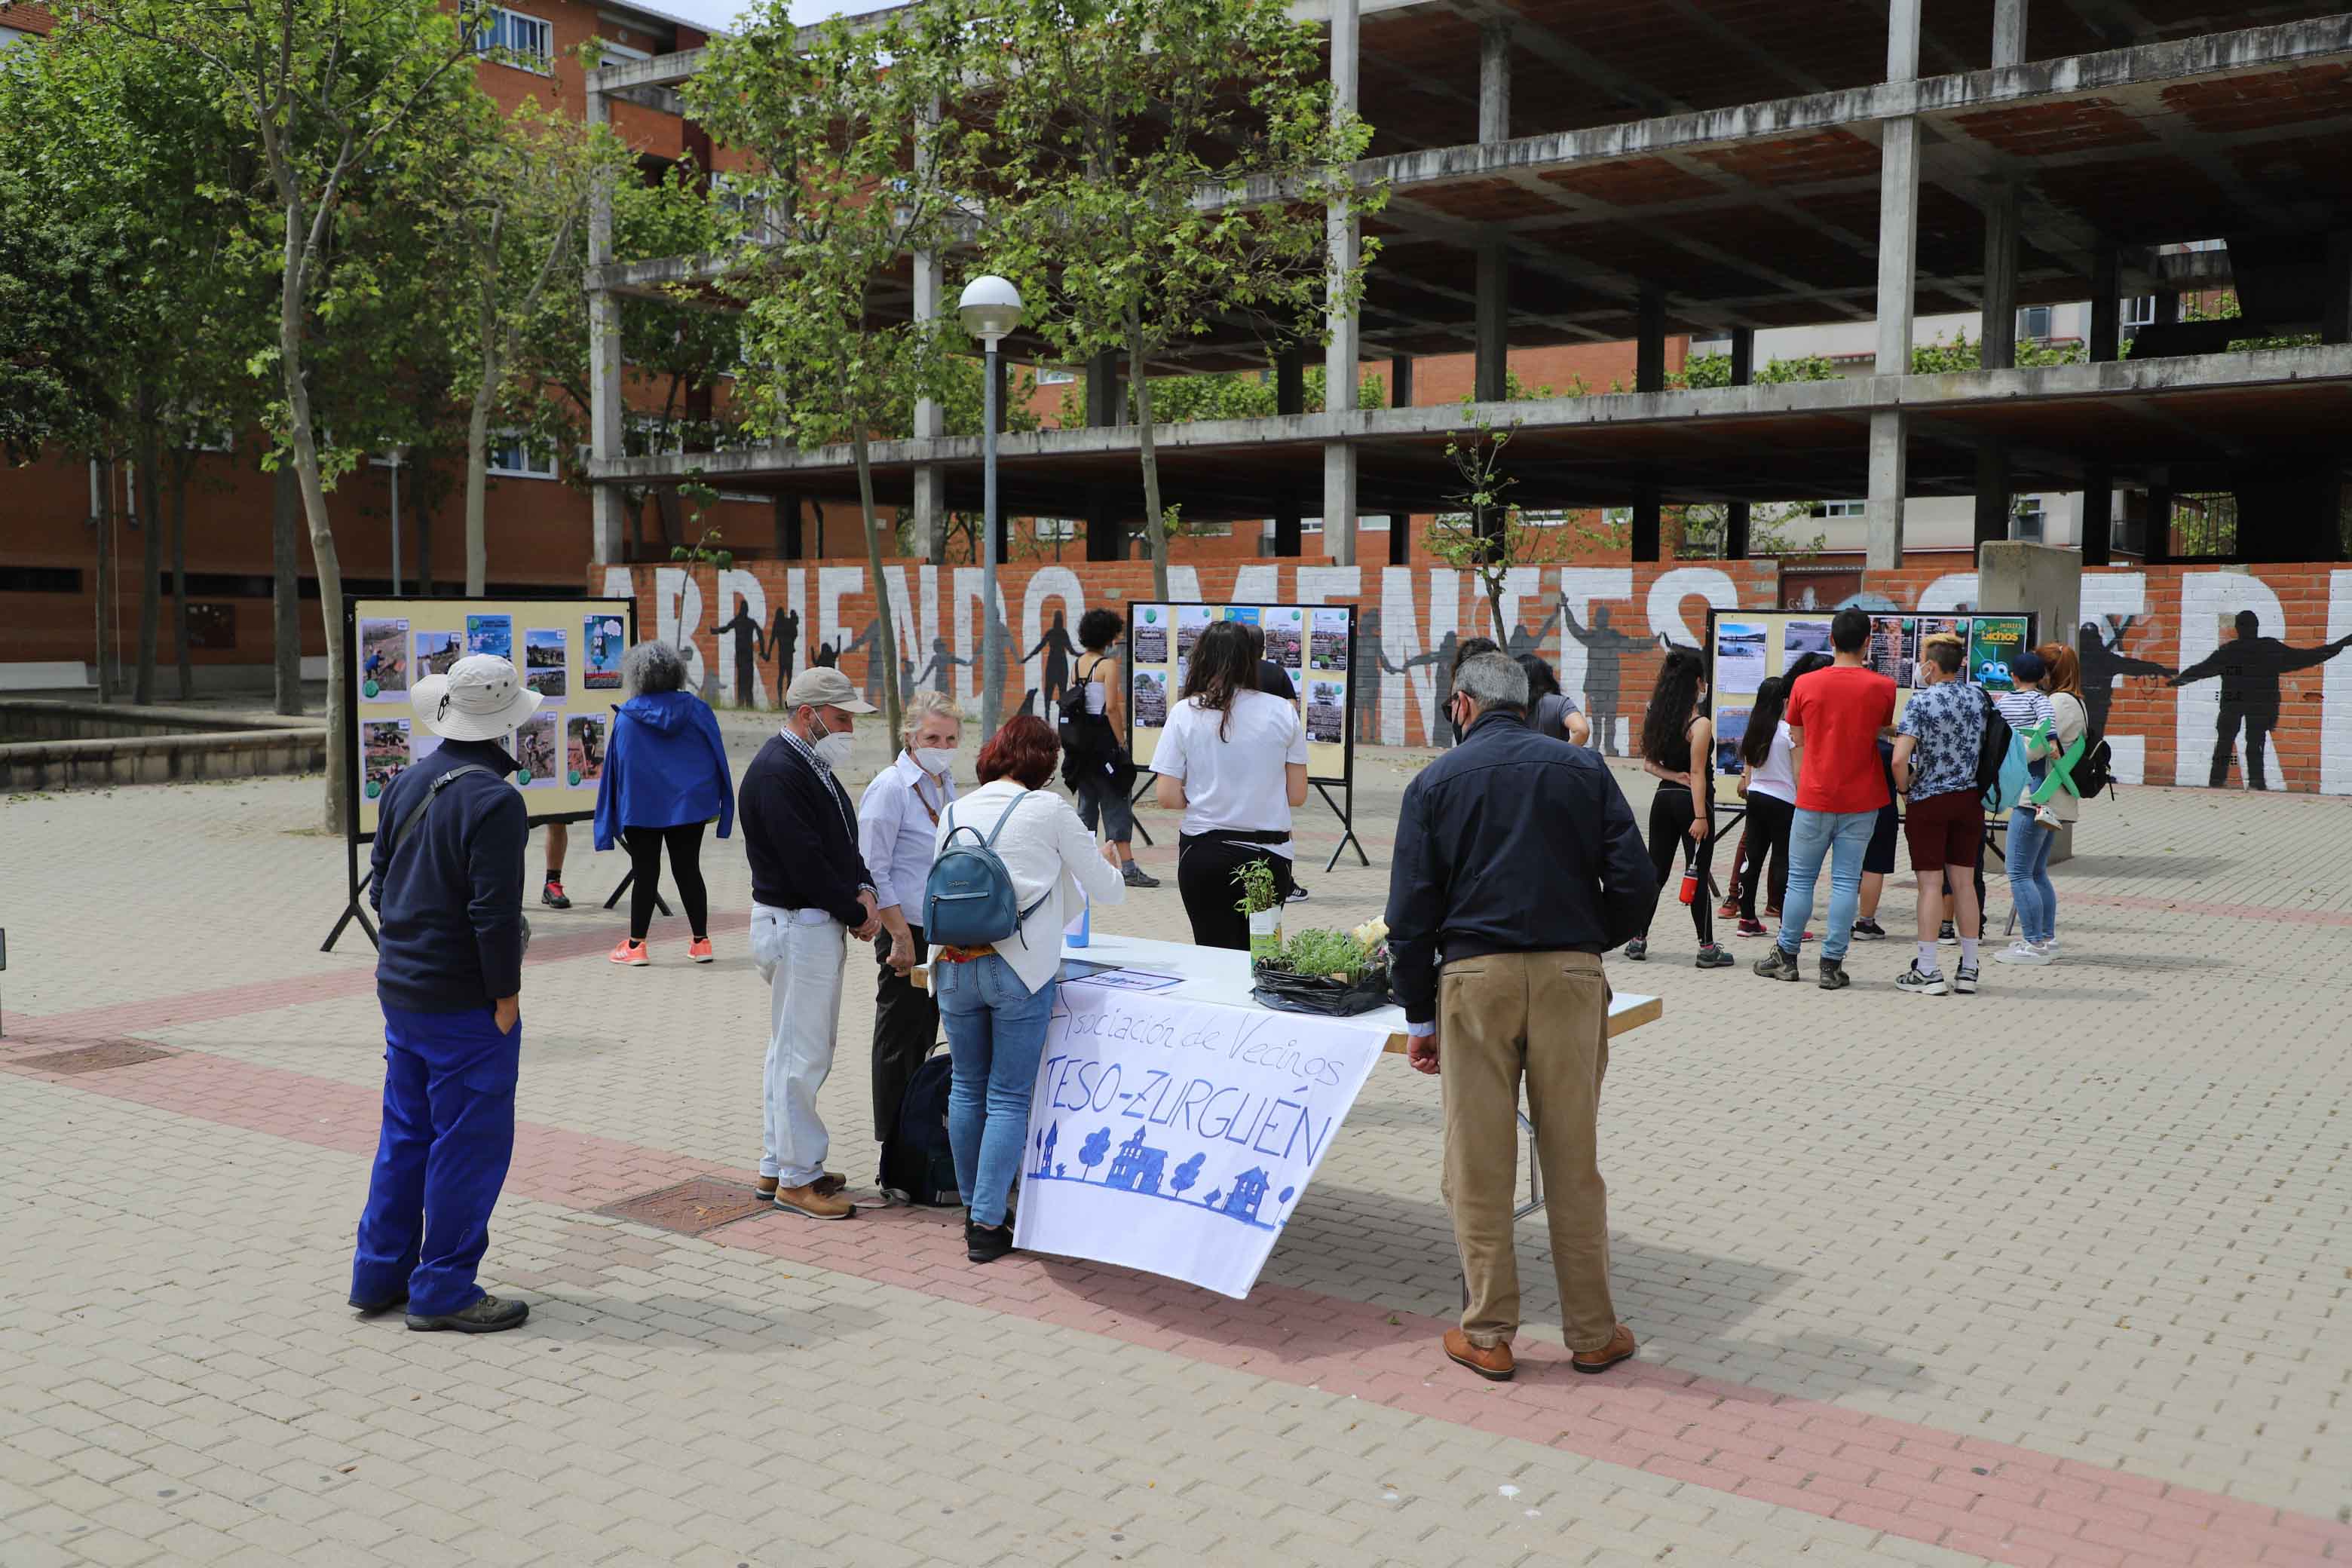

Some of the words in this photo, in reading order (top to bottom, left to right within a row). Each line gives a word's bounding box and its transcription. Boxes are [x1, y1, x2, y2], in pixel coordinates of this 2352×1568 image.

[1050, 985, 1174, 1049] Asociación
[1181, 1014, 1220, 1050] de
[1229, 1012, 1345, 1086] Vecinos
[1045, 1055, 1332, 1167] TESO-ZURGUÉN
